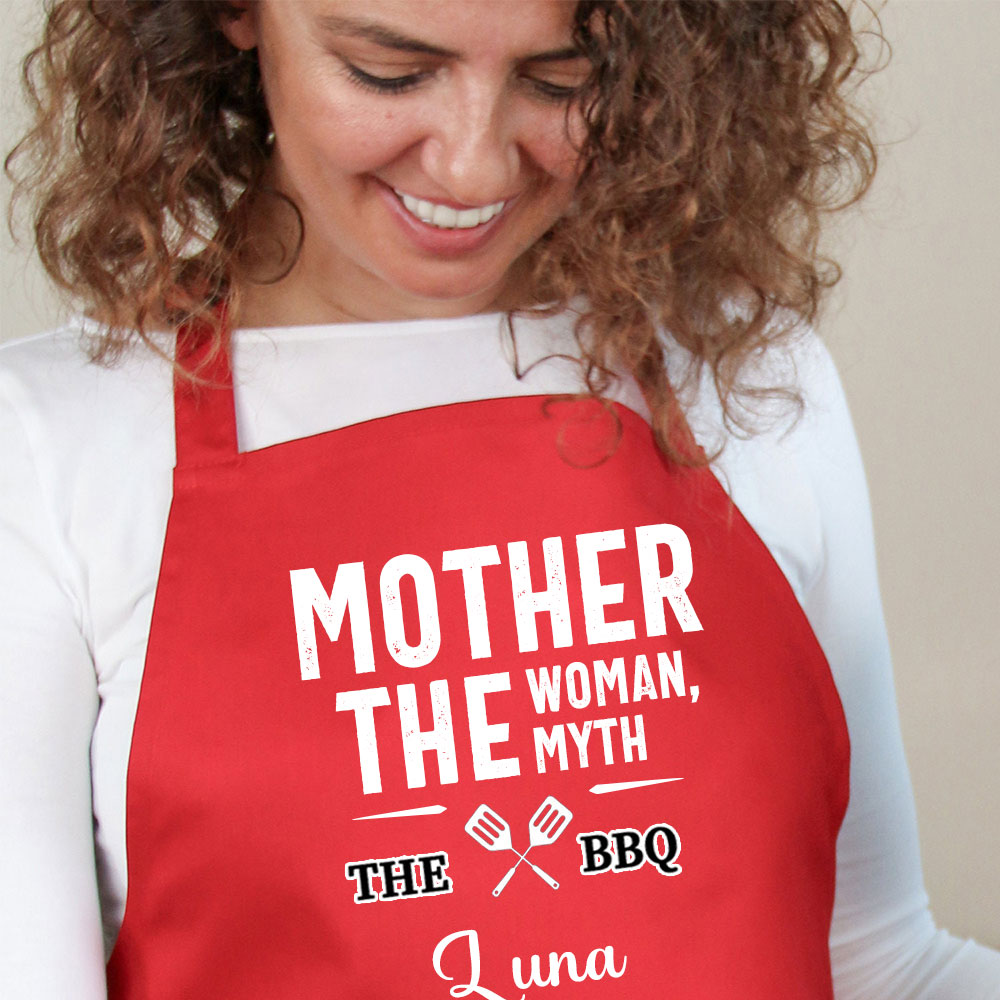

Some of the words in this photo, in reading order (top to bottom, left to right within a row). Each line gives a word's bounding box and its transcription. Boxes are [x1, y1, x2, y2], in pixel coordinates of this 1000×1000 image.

[290, 524, 704, 680] MOTHER
[336, 672, 520, 794] THE
[526, 650, 699, 713] WOMAN,
[533, 715, 647, 773] MYTH
[345, 851, 453, 904] THE
[576, 823, 682, 876] BBQ
